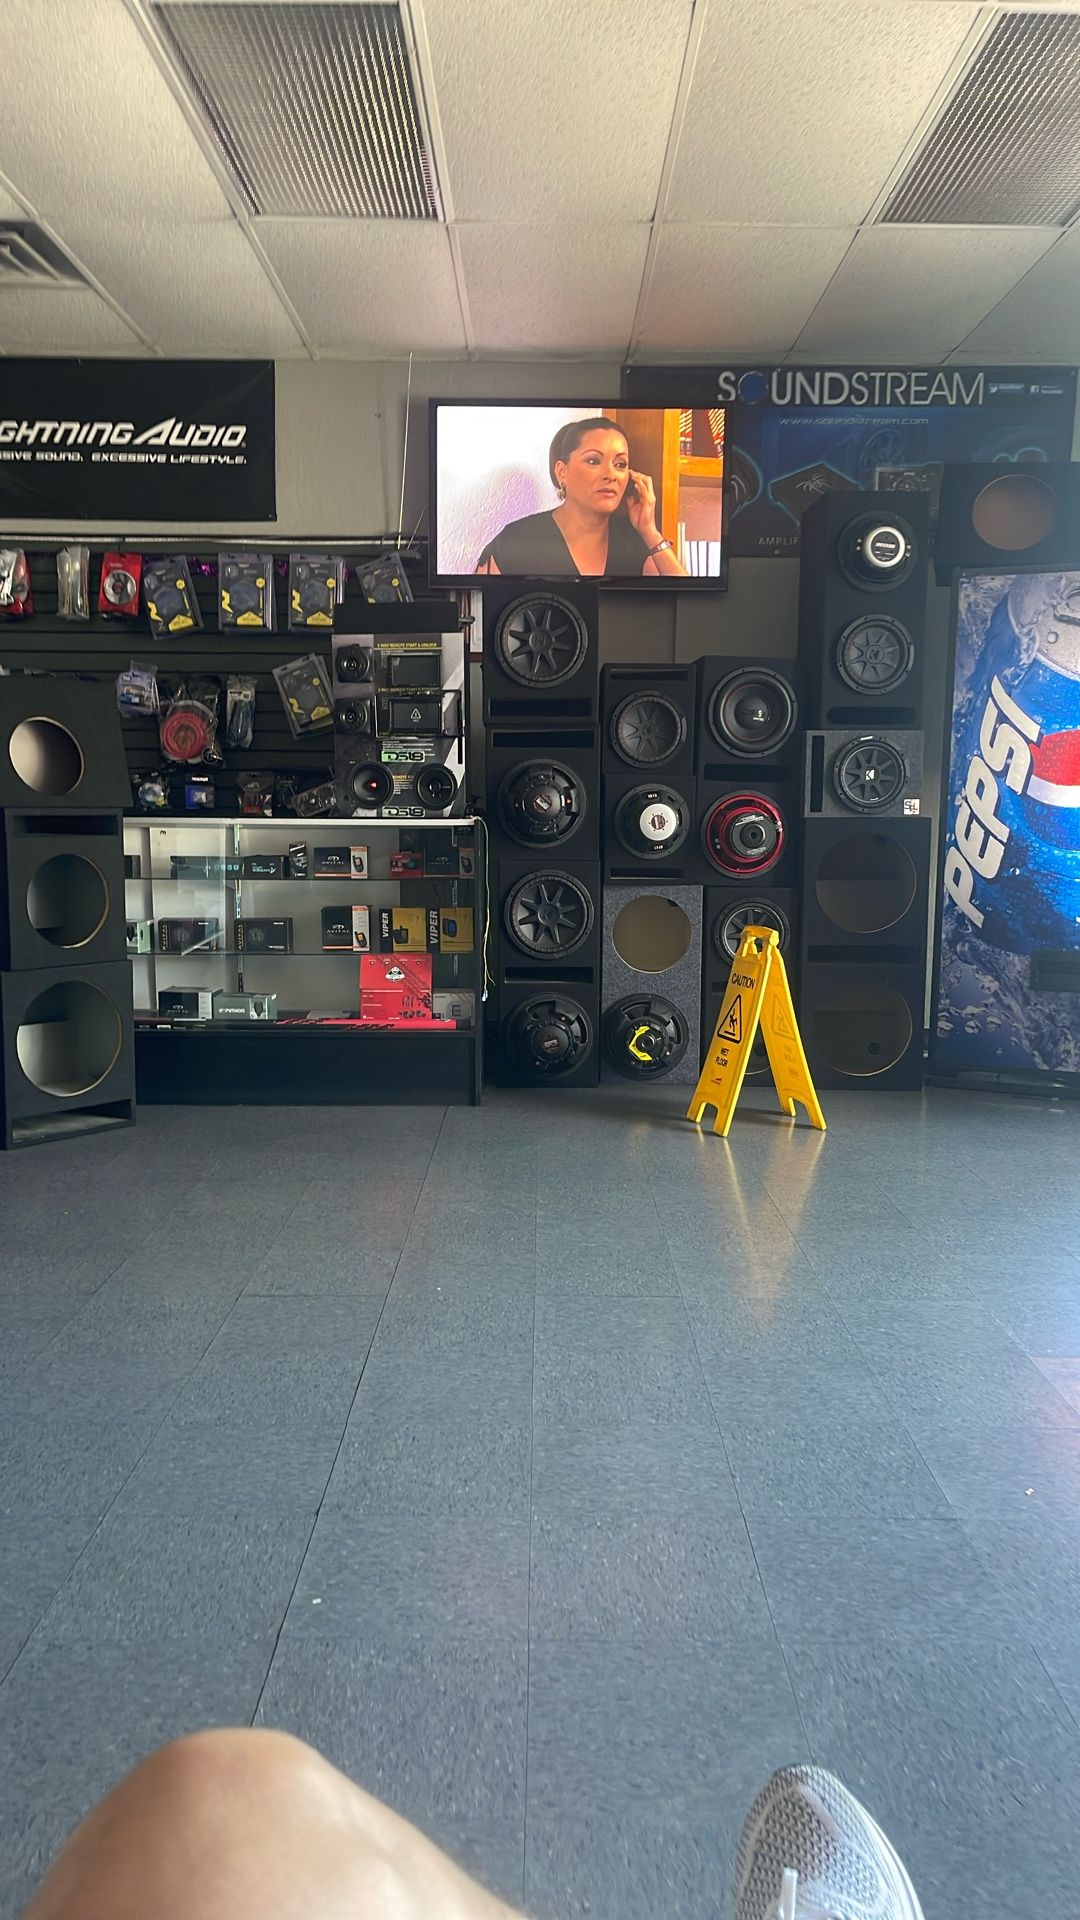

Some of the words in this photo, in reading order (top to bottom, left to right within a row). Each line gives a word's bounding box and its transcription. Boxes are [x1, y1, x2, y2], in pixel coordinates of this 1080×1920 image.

[717, 370, 985, 406] SOUNDSTREAM
[133, 416, 246, 448] AUDIO
[778, 417, 929, 426] www.soundstream.com
[0, 450, 33, 462] SIVE
[91, 452, 167, 464] EXCESSIVE
[944, 676, 1041, 928] PEPSI
[381, 912, 389, 938] VIPER
[429, 910, 438, 944] VIPER
[731, 972, 756, 990] CAUTION
[714, 1056, 728, 1068] FLOOR
[720, 1047, 730, 1056] WET
